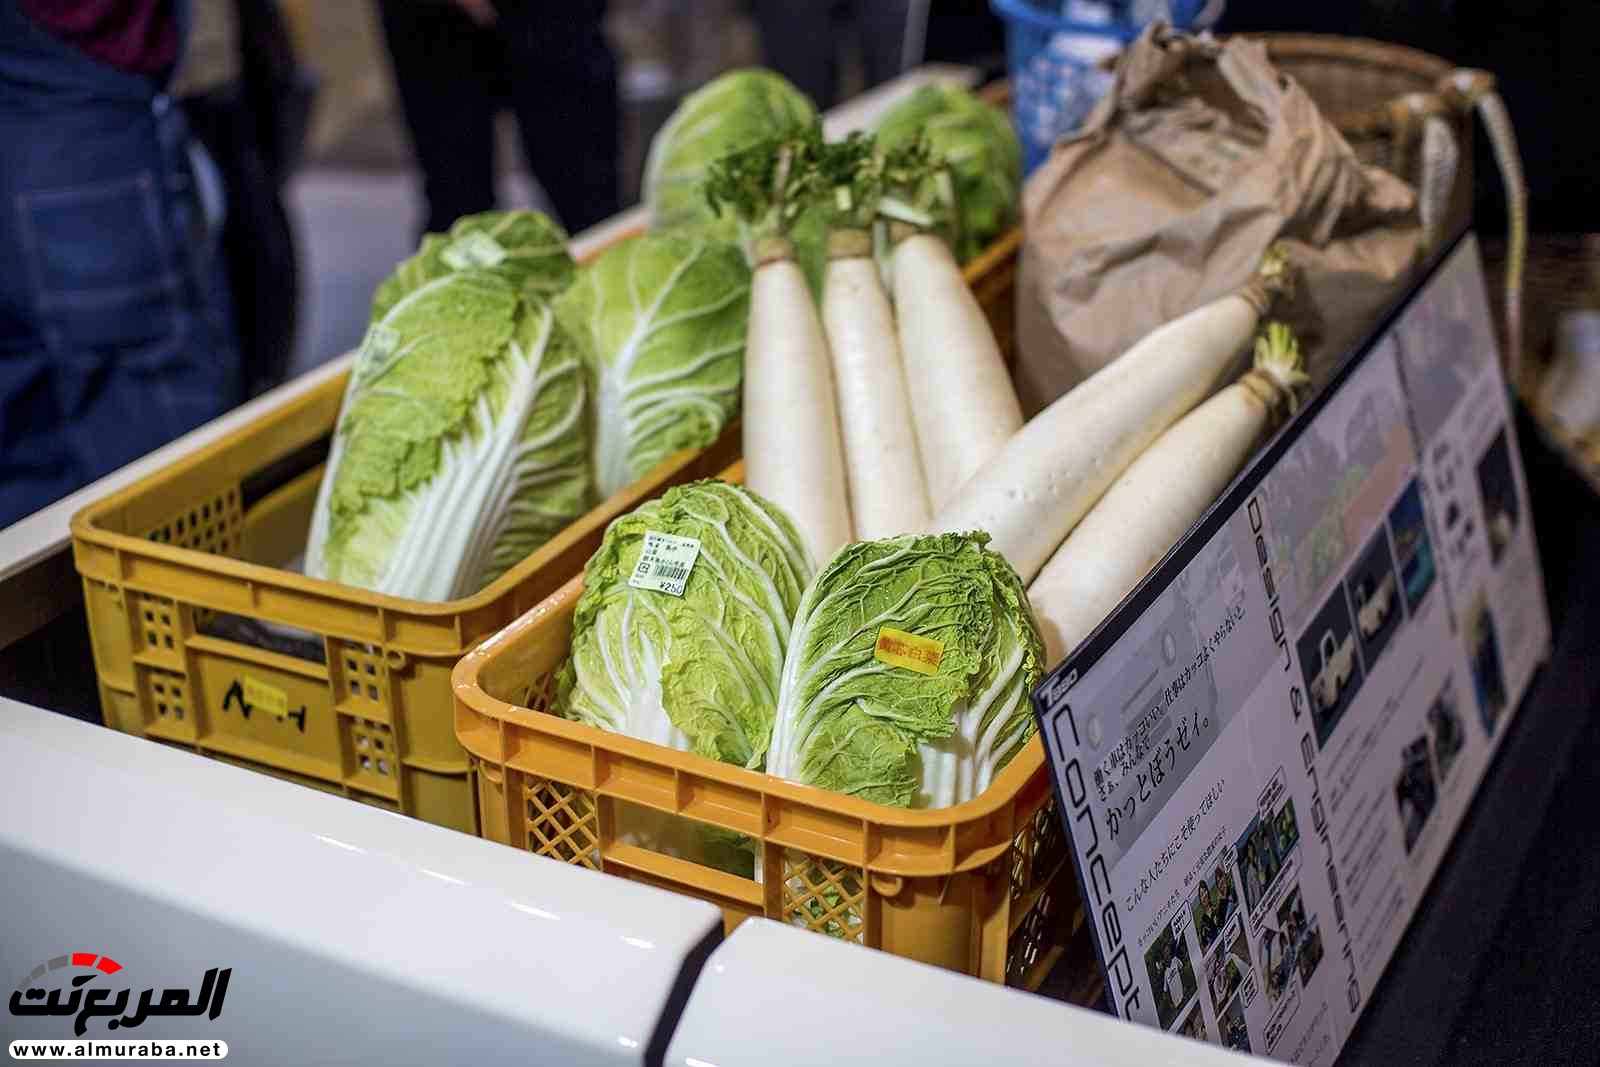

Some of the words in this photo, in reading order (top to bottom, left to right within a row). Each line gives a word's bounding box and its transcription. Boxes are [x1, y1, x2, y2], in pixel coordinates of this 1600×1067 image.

[1052, 704, 1140, 1022] Concept
[1248, 496, 1291, 672] Design
[1289, 686, 1302, 721] &
[1300, 732, 1362, 1013] Engineering
